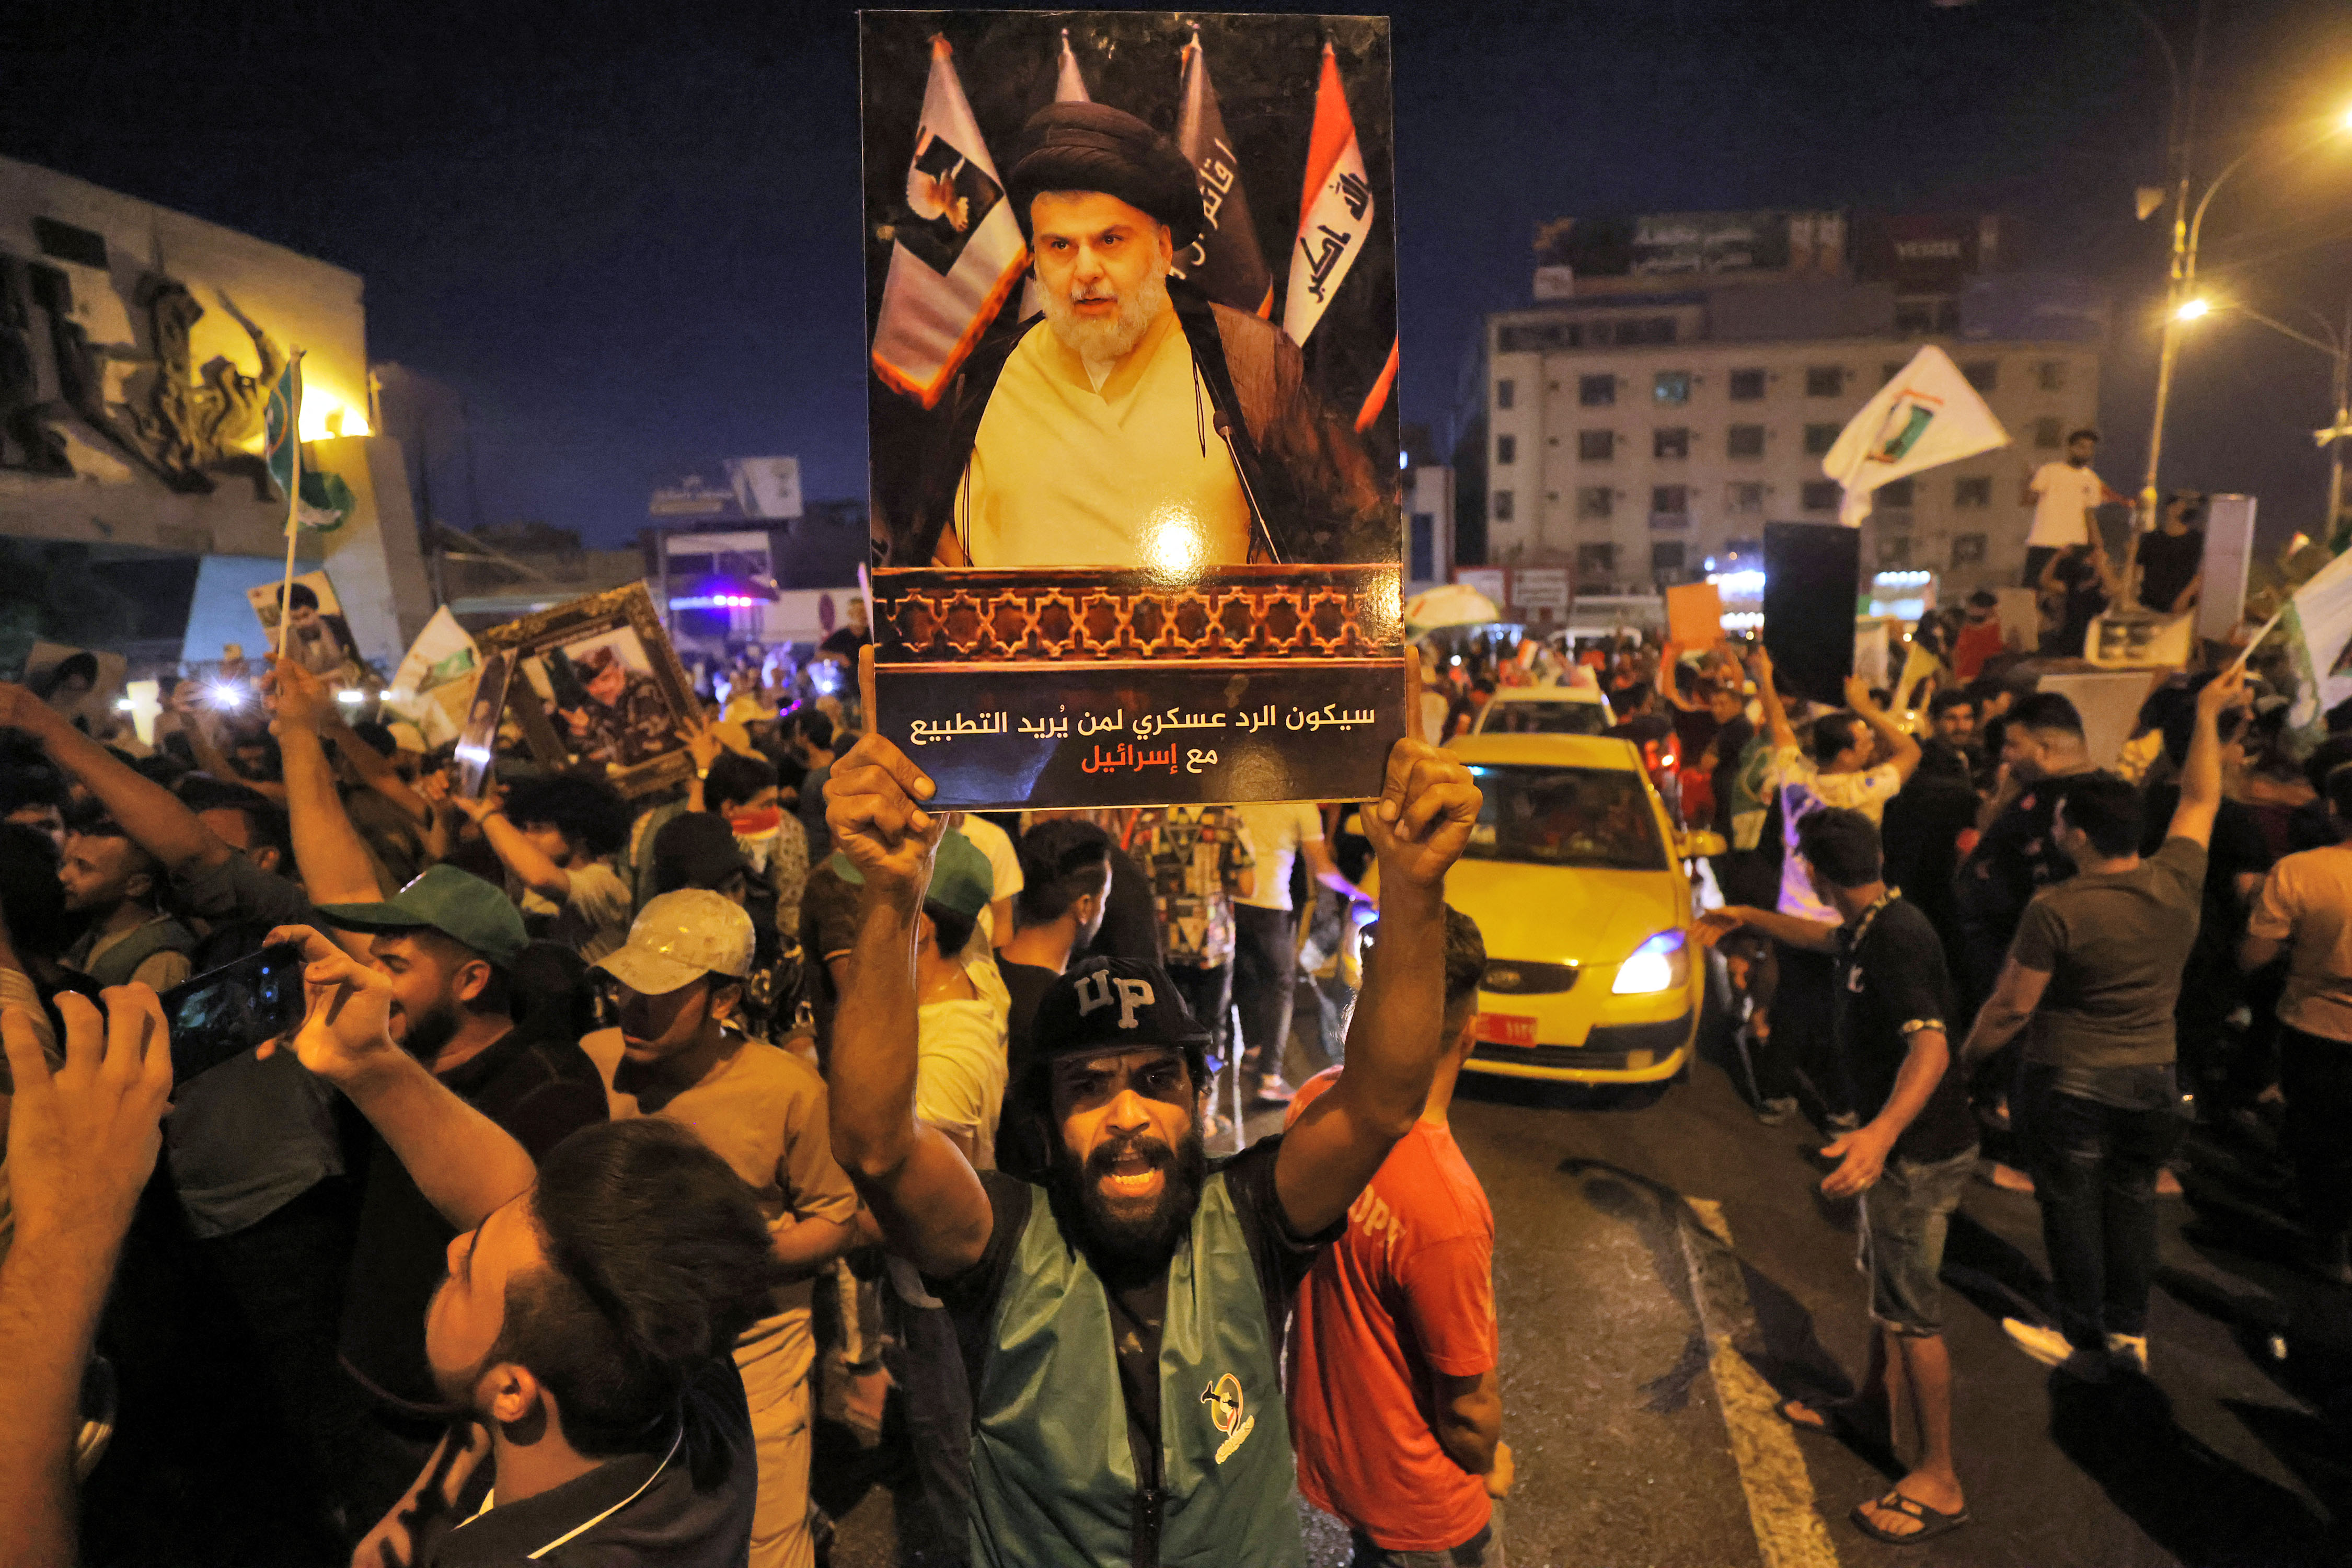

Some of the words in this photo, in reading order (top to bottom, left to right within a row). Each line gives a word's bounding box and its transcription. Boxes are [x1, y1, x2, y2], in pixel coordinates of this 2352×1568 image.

[910, 711, 1008, 746] التطبيع
[1017, 704, 1069, 740] يُريد
[1077, 708, 1123, 736] لمن
[1132, 707, 1226, 741] عسكري
[1235, 705, 1276, 733] الرد
[1285, 703, 1376, 732] سيكون
[1081, 743, 1179, 775] إسرائيل
[1185, 747, 1219, 775] مع
[1074, 969, 1156, 1030] UP
